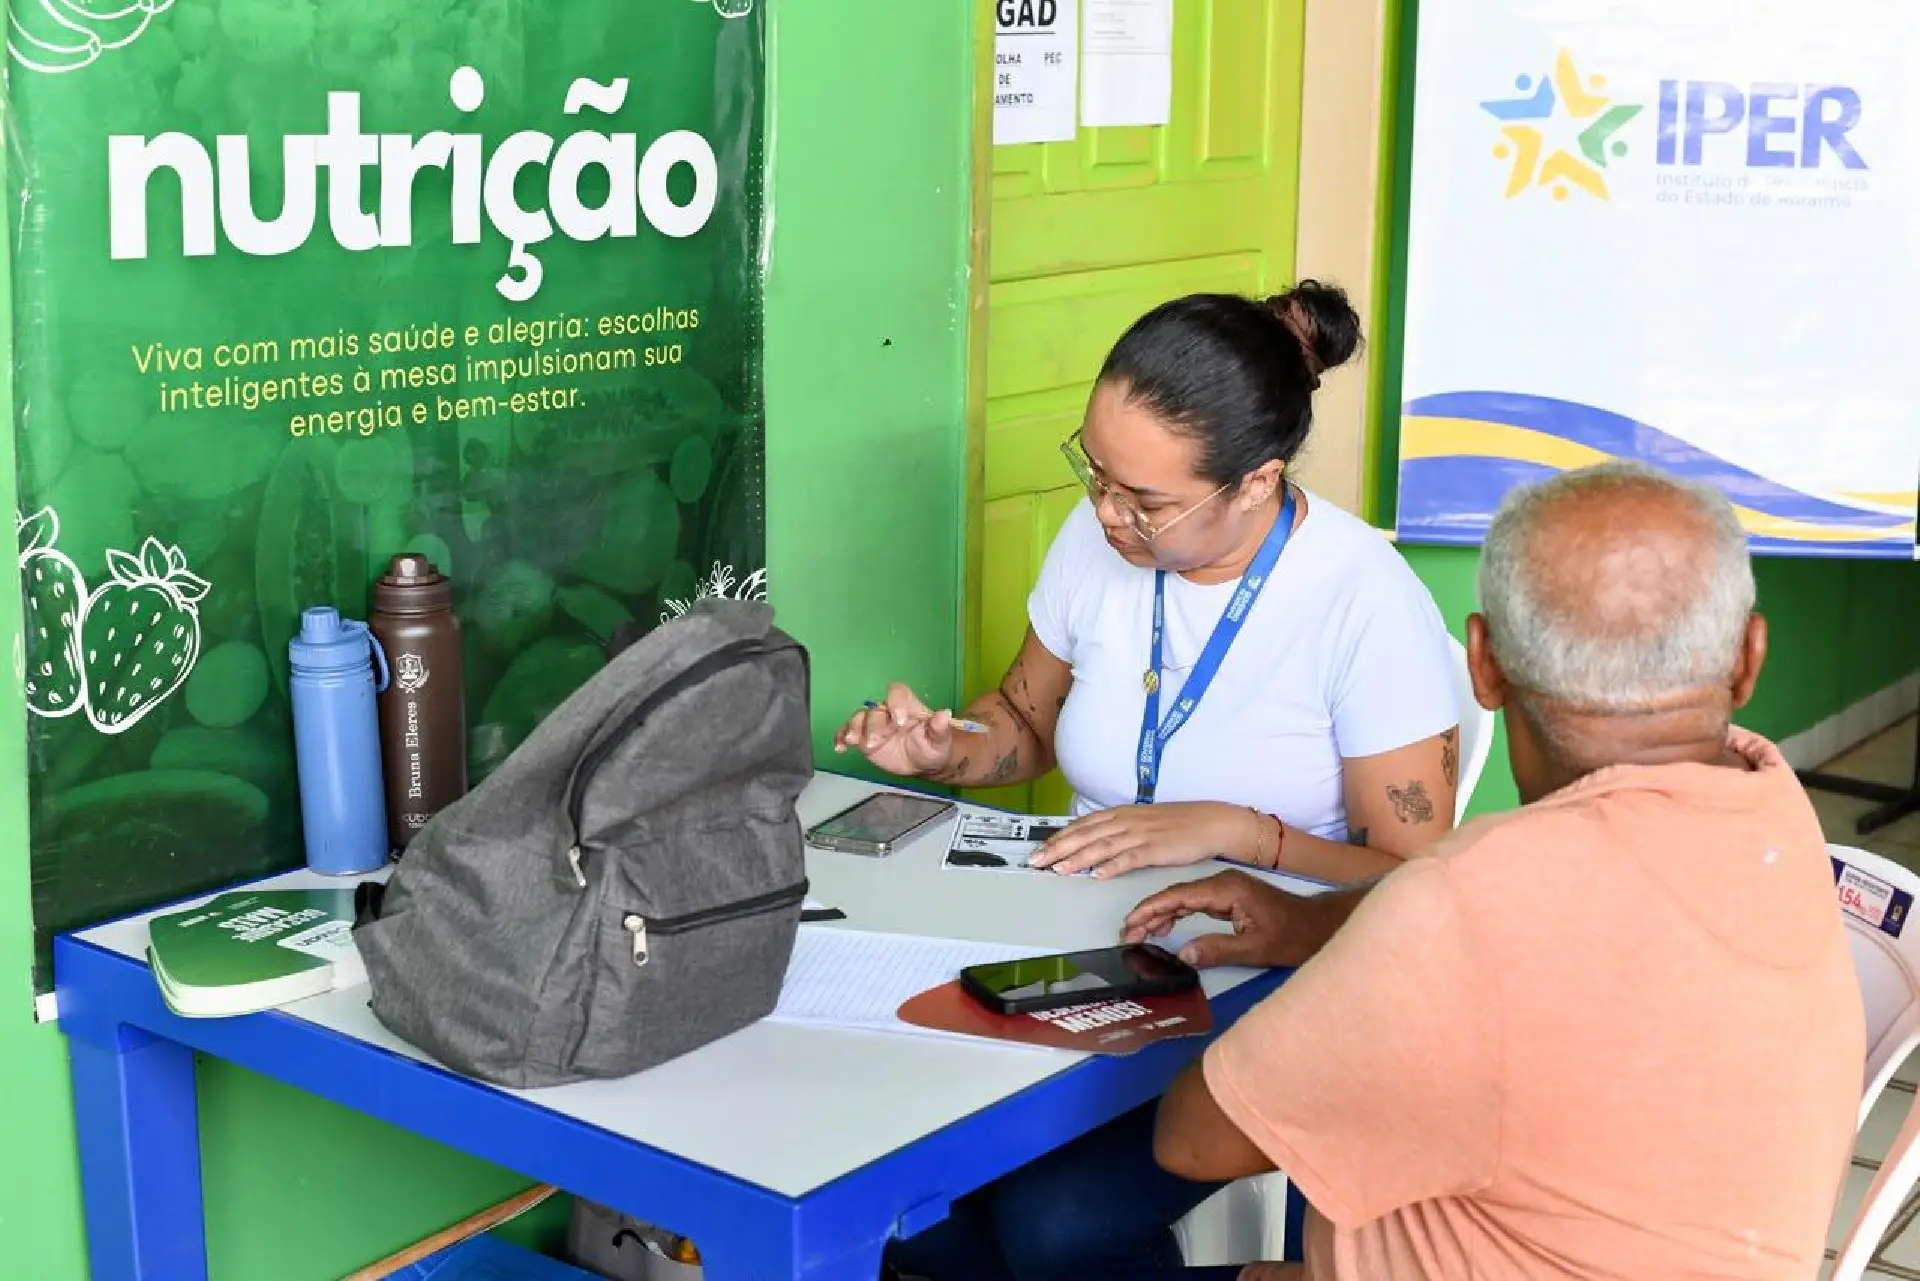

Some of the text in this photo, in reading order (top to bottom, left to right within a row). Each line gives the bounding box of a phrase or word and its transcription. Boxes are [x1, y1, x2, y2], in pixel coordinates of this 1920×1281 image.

[999, 73, 1012, 86] DE
[1656, 79, 1869, 170] IPER
[108, 66, 719, 301] nutrição
[132, 306, 699, 374] Viva com mais saúde e alegria: escolhas
[160, 343, 683, 412] inteligentes à mesa impulsionam sua
[290, 385, 587, 437] energia e bem-estar.
[409, 752, 422, 799] Bruna
